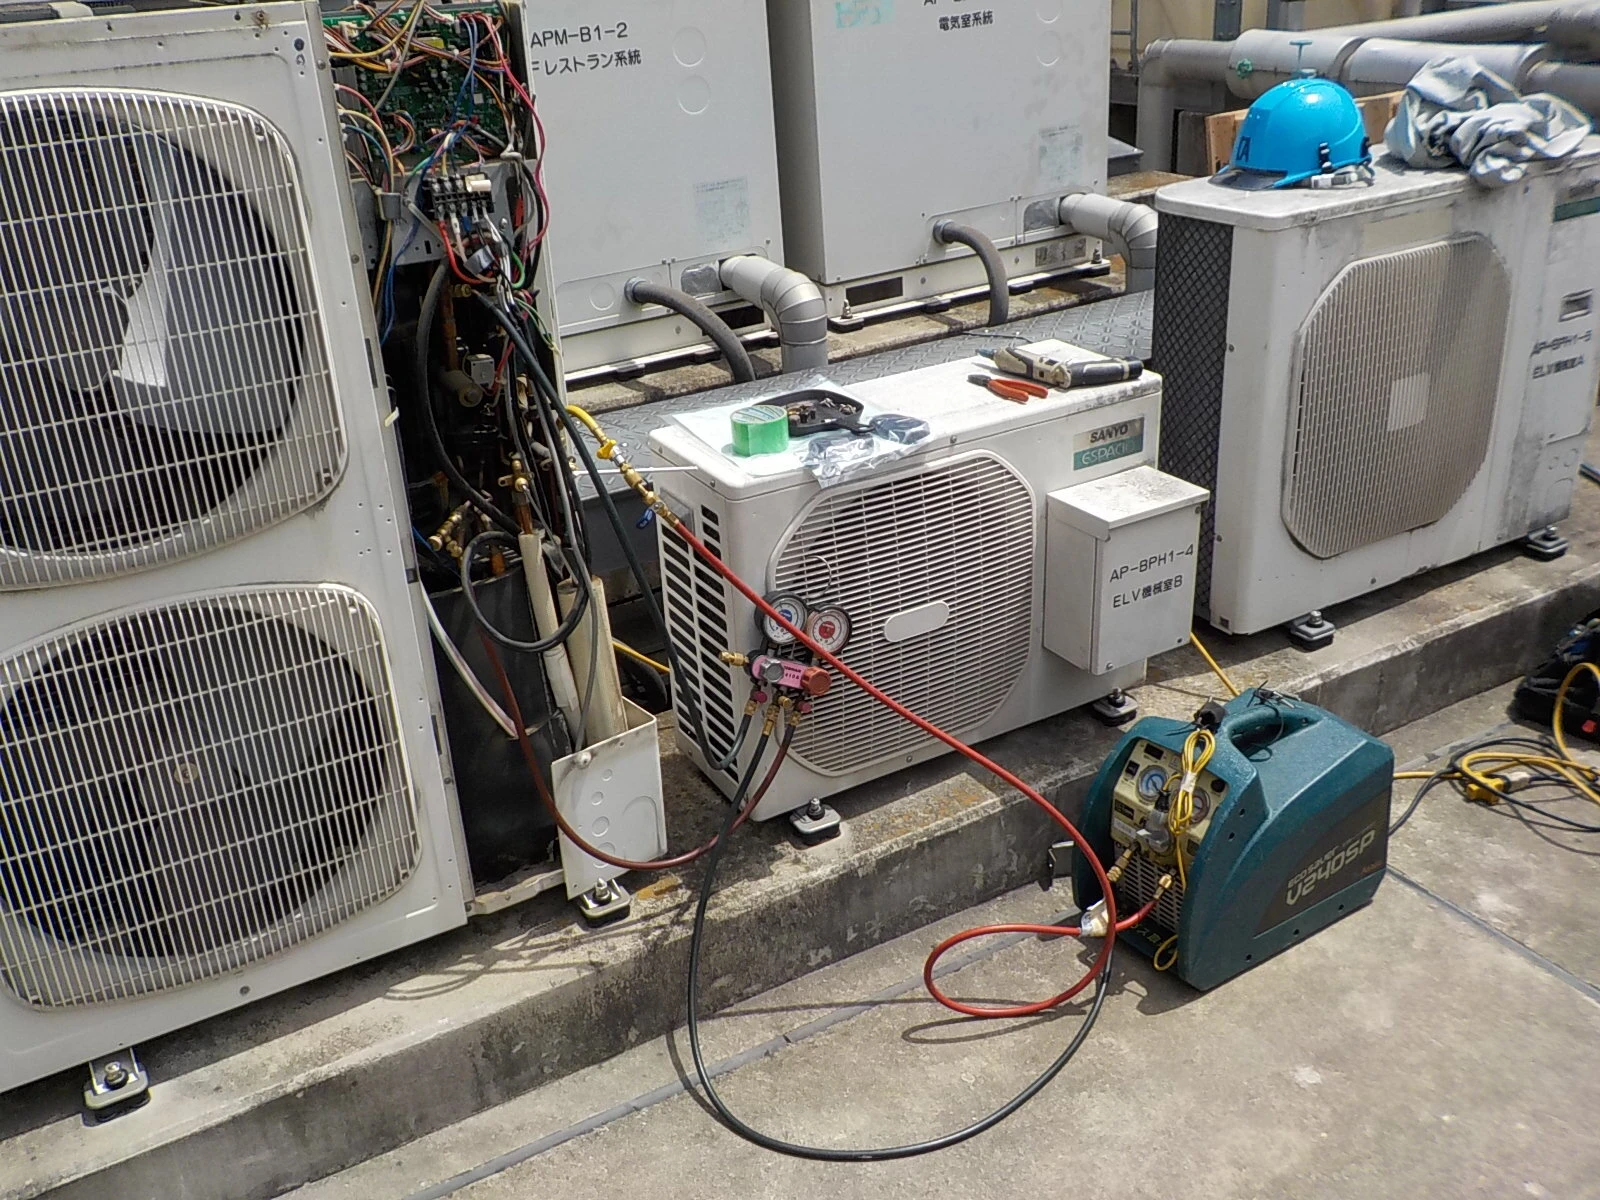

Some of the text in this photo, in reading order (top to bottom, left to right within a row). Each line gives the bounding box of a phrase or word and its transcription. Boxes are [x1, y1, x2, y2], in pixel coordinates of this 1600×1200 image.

[938, 10, 994, 31] 電気室系統
[530, 22, 628, 48] APM-B1-2
[1090, 424, 1129, 443] SANYO
[1109, 543, 1194, 583] AP-BPH1-4
